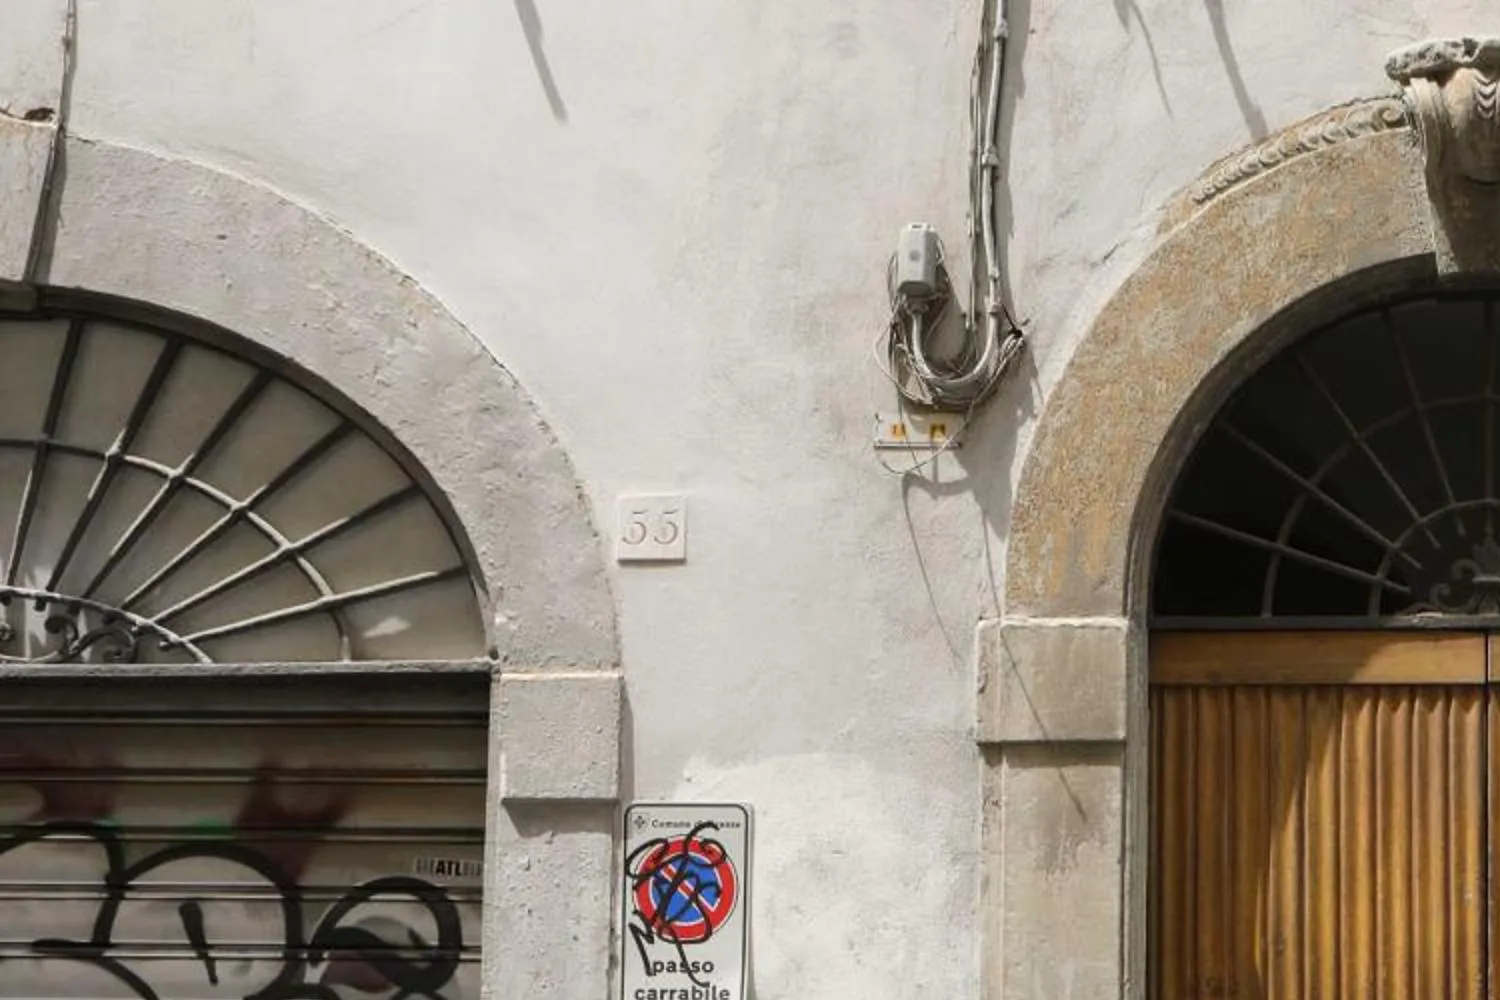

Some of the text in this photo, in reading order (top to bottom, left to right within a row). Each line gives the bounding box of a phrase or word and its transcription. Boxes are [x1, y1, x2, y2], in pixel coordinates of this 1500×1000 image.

[621, 509, 679, 546] 55
[652, 960, 715, 976] passo
[634, 984, 731, 1000] carrabile
